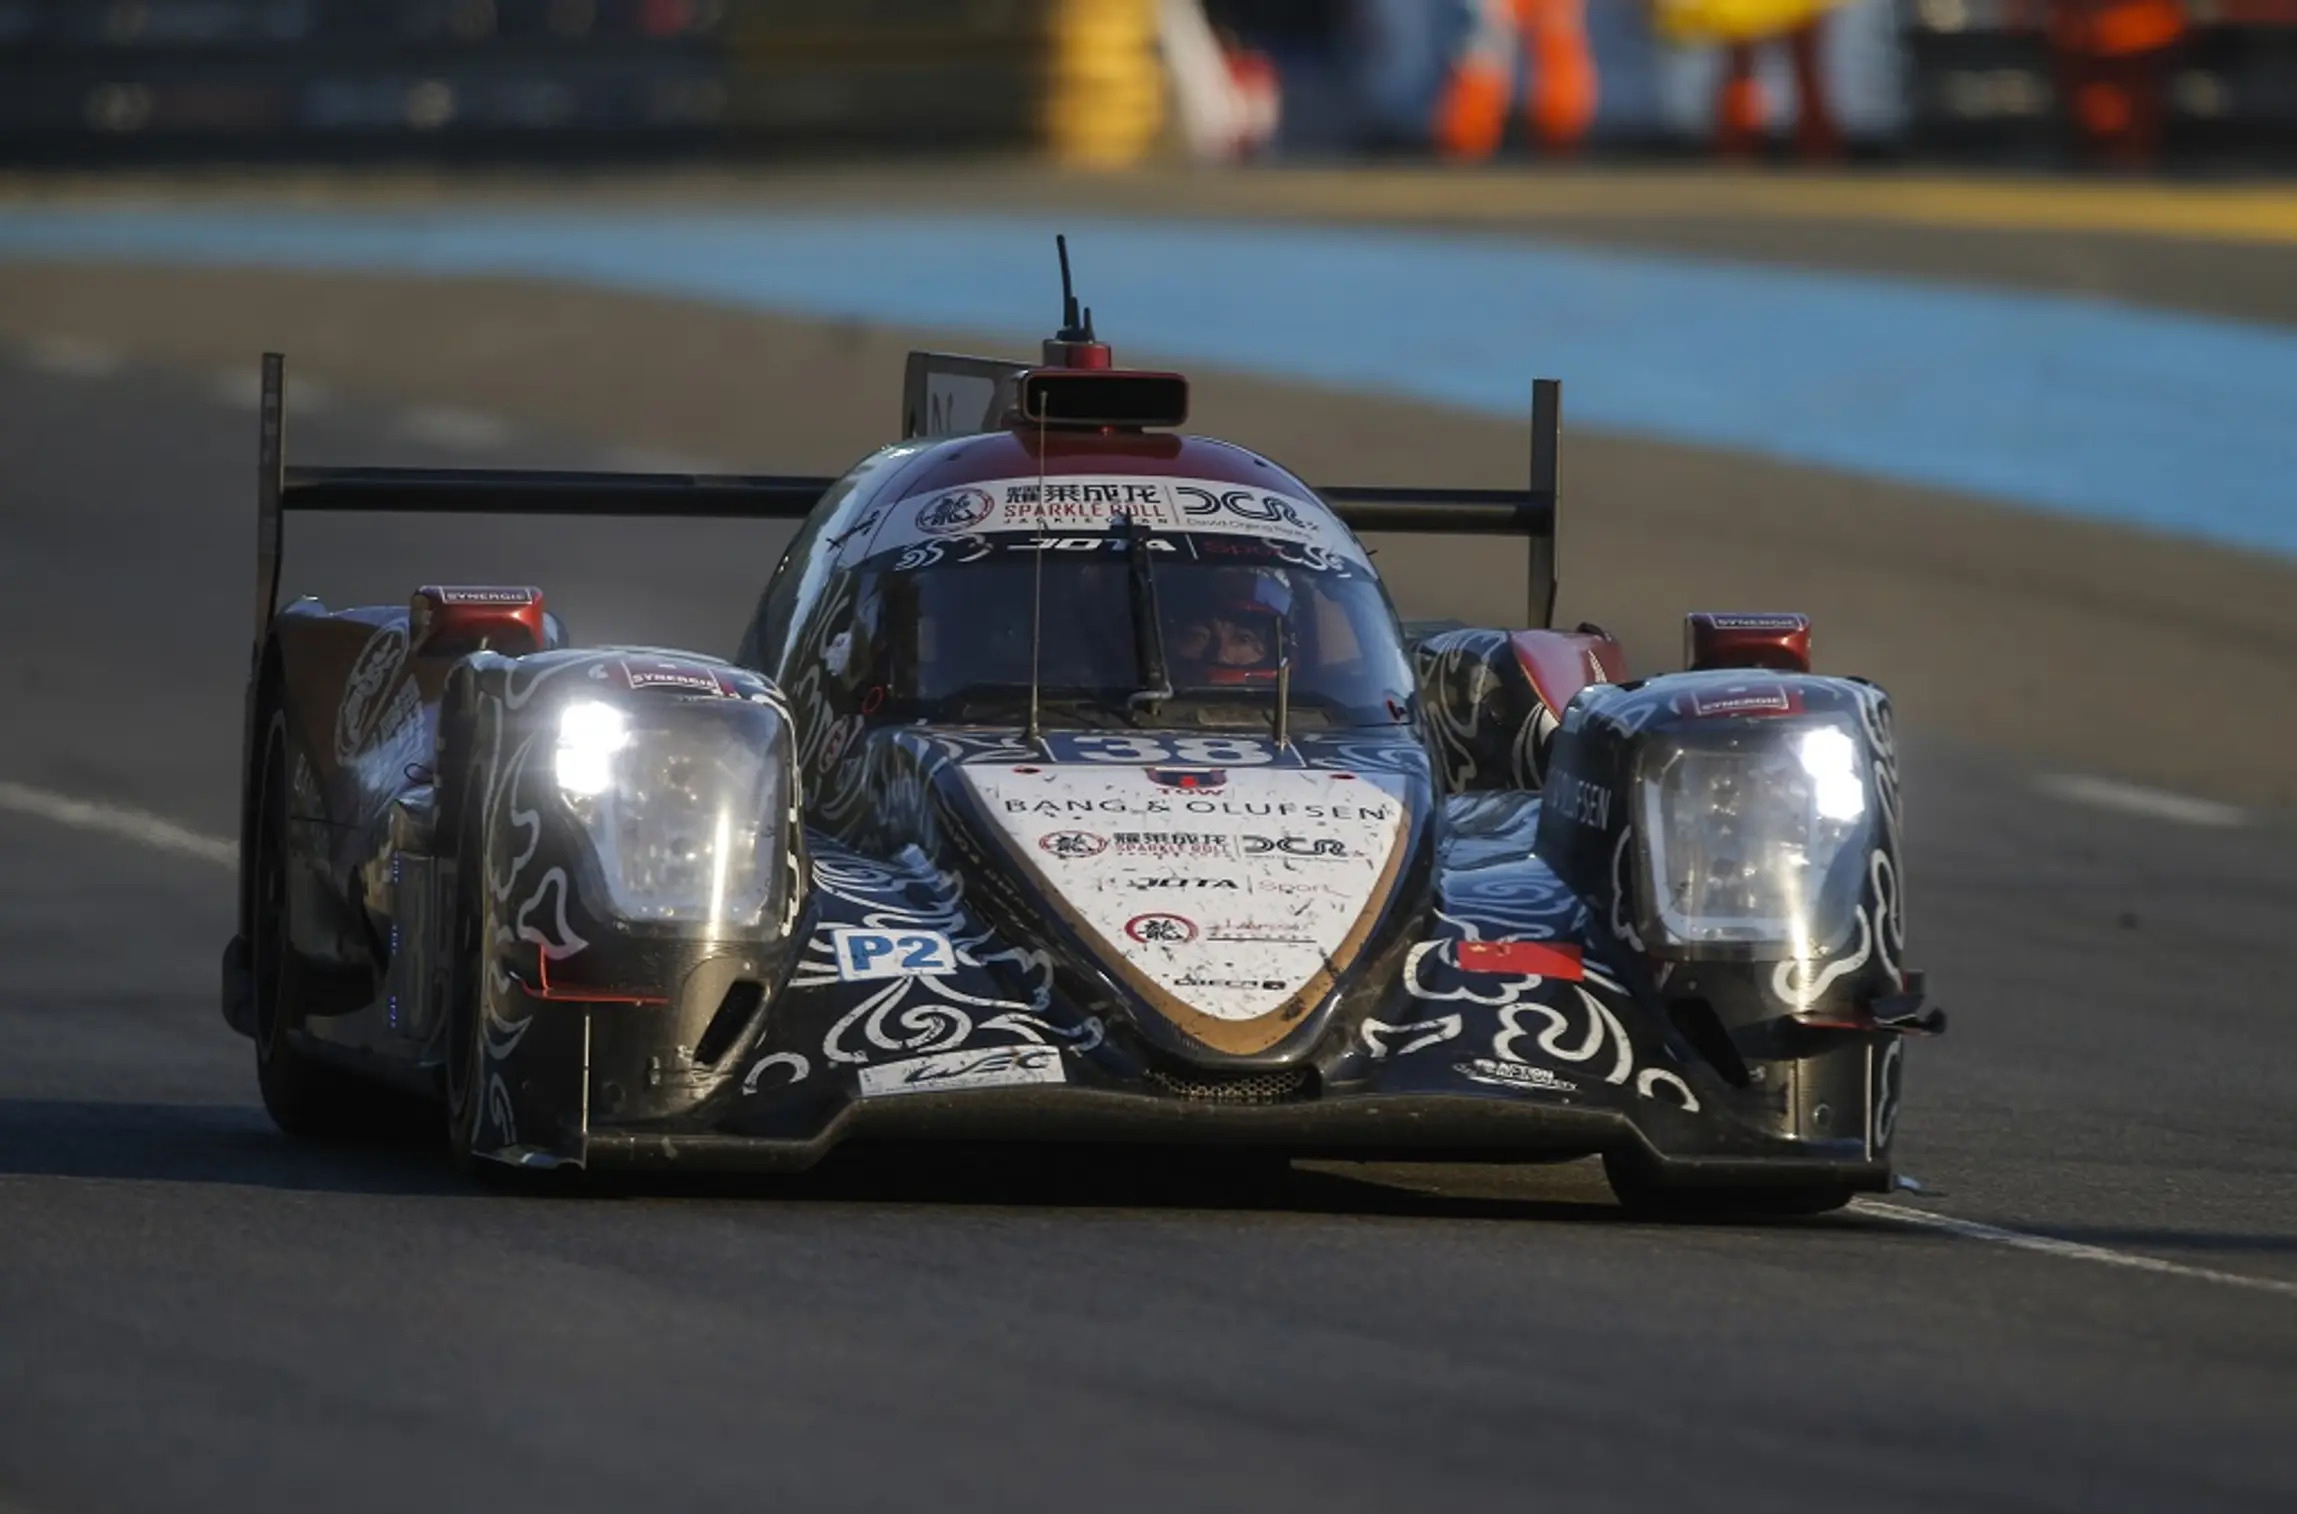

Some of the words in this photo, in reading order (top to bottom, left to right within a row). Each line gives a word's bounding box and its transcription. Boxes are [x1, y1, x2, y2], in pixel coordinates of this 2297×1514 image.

[1003, 503, 1102, 518] SPARKLE
[1109, 504, 1165, 518] ROLL
[1073, 736, 1273, 763] 38
[1005, 799, 1127, 812] BANG
[1148, 800, 1170, 812] &
[1186, 800, 1387, 821] OLUFSEN
[1127, 878, 1239, 890] JOTA
[847, 935, 945, 971] P2
